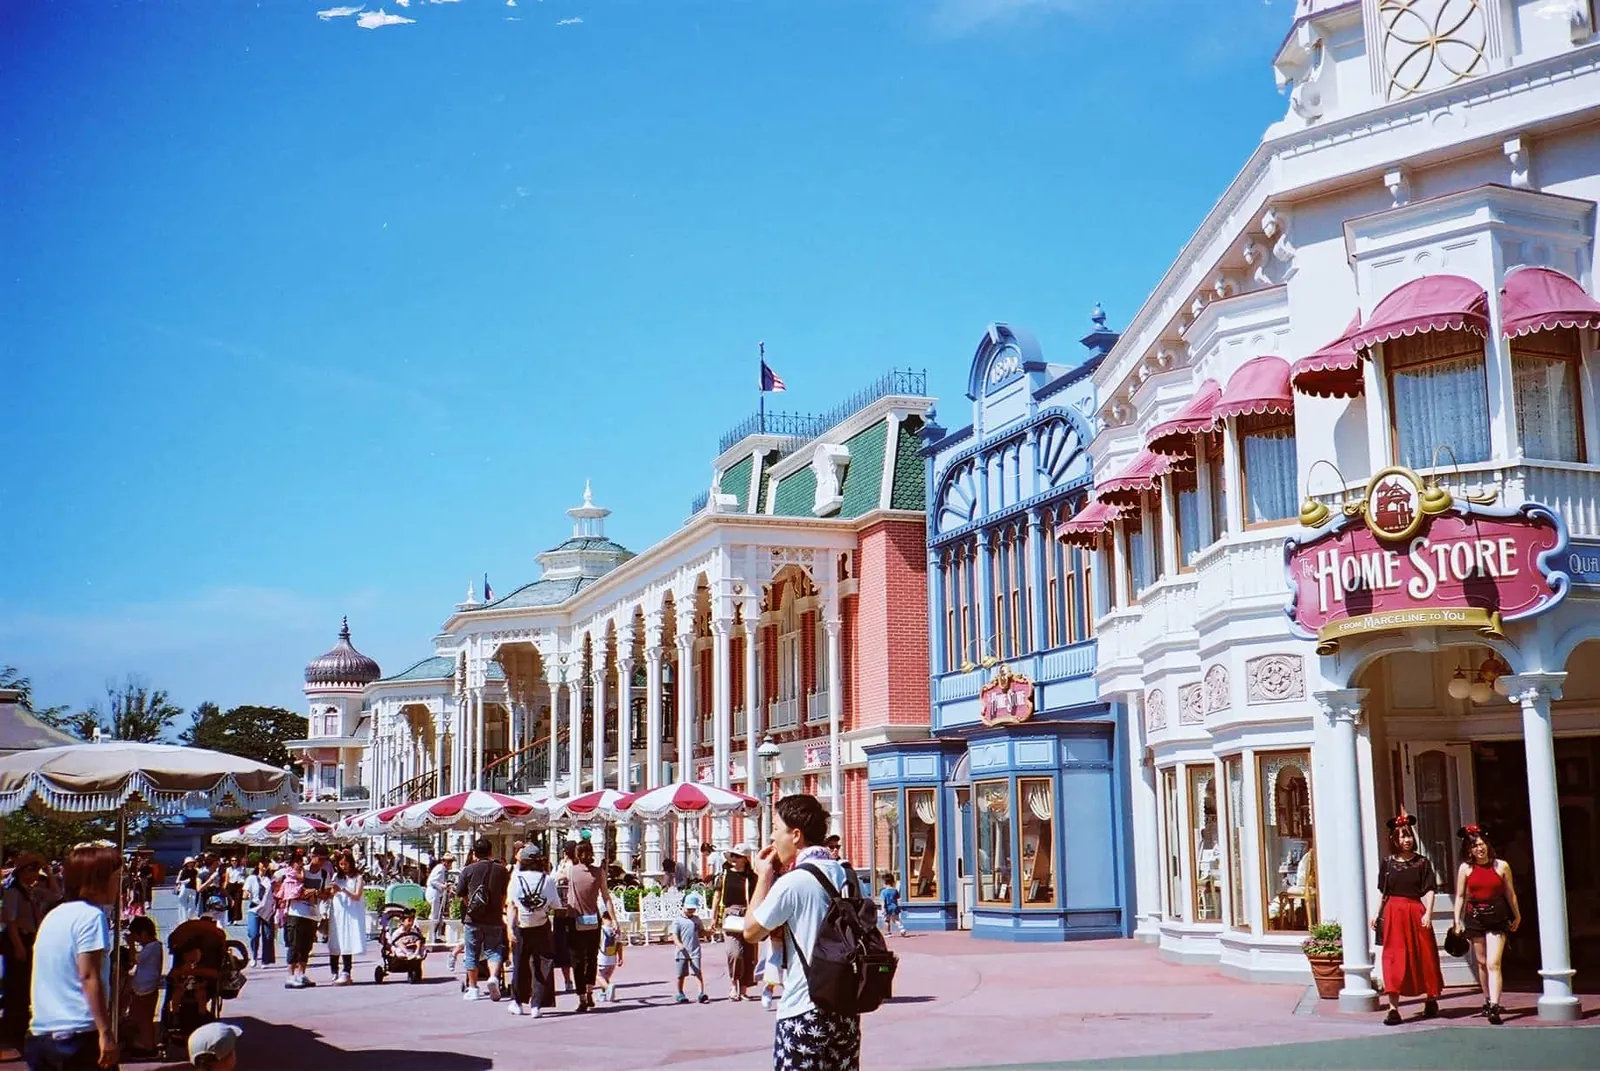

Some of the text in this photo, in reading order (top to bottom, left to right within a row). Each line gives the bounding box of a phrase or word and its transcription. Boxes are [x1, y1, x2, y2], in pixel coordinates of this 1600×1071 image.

[1314, 549, 1402, 612] HOME
[1408, 537, 1519, 599] STORE
[1339, 621, 1361, 631] FROM
[1363, 612, 1427, 629] MARCELINE
[1441, 610, 1465, 621] YOU
